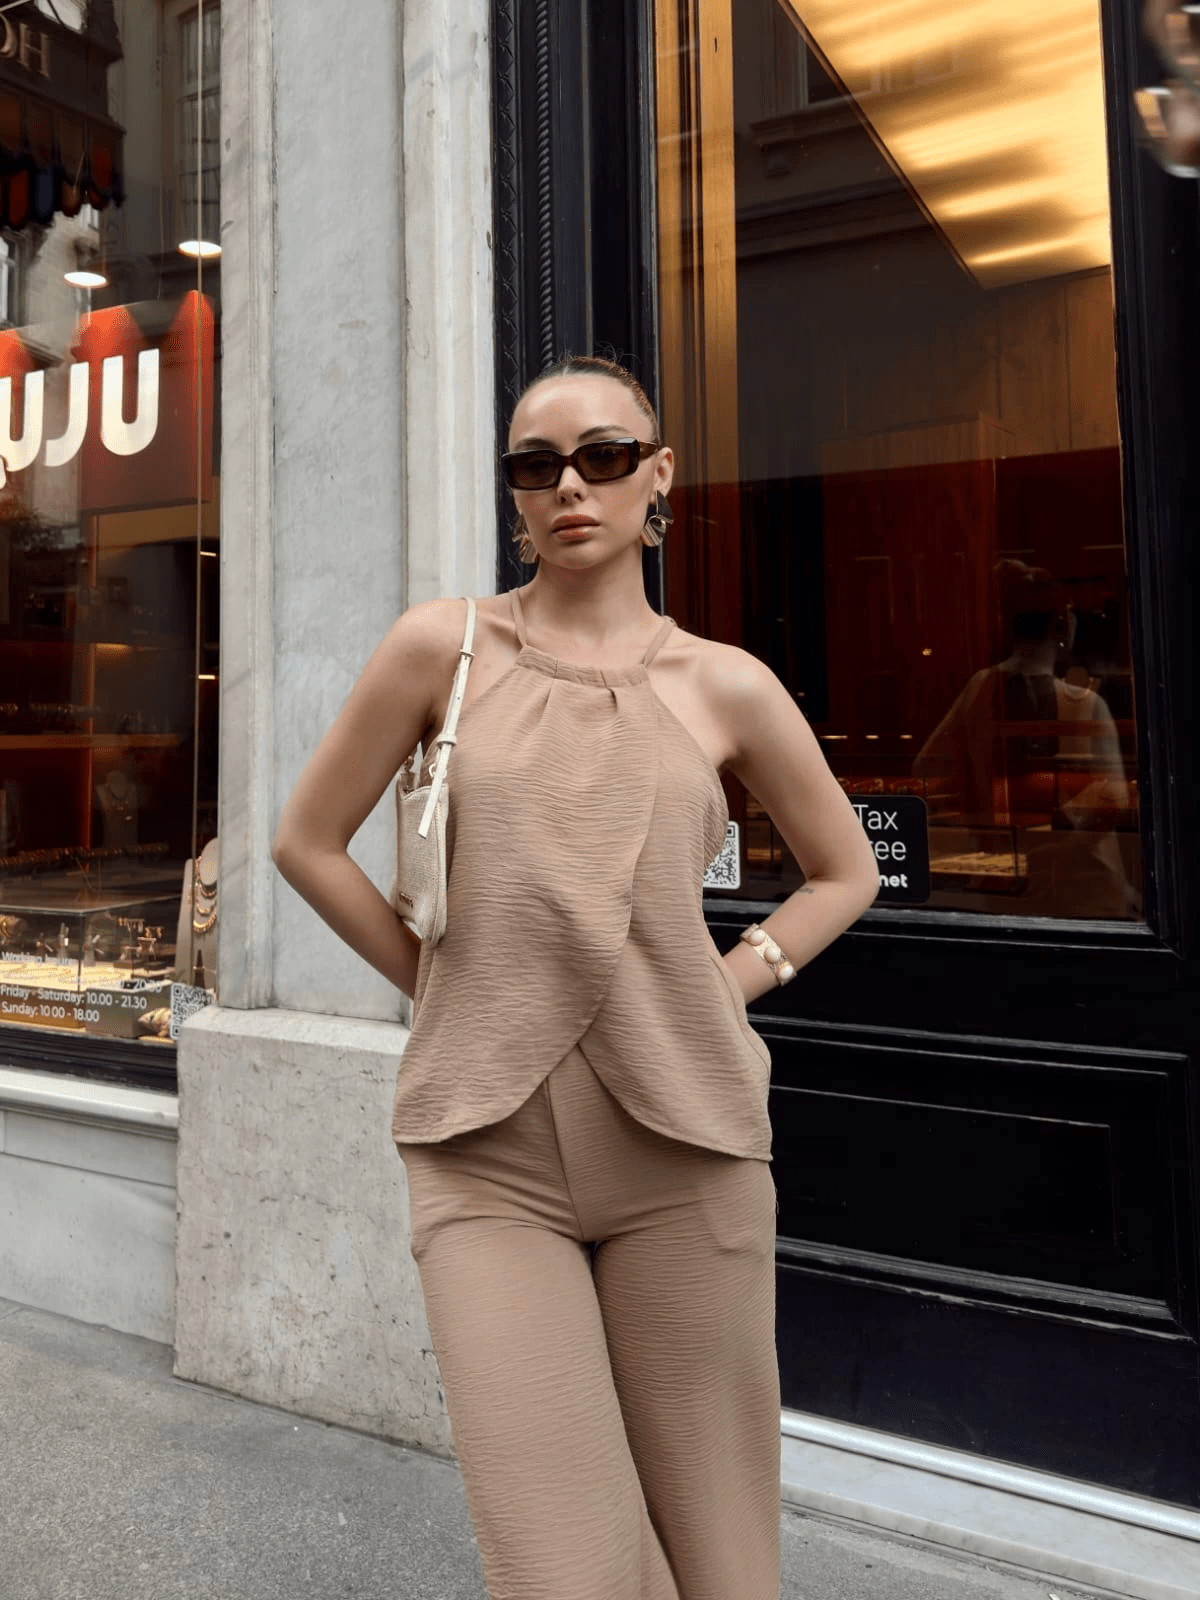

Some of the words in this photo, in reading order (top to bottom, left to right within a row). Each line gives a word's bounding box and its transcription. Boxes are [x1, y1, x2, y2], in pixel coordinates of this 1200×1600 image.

[852, 804, 898, 830] Tax
[870, 840, 907, 861] ee
[0, 984, 29, 1000] Friday
[86, 992, 113, 1006] 10.00
[120, 995, 147, 1009] 21.30
[73, 1007, 100, 1022] 18.00
